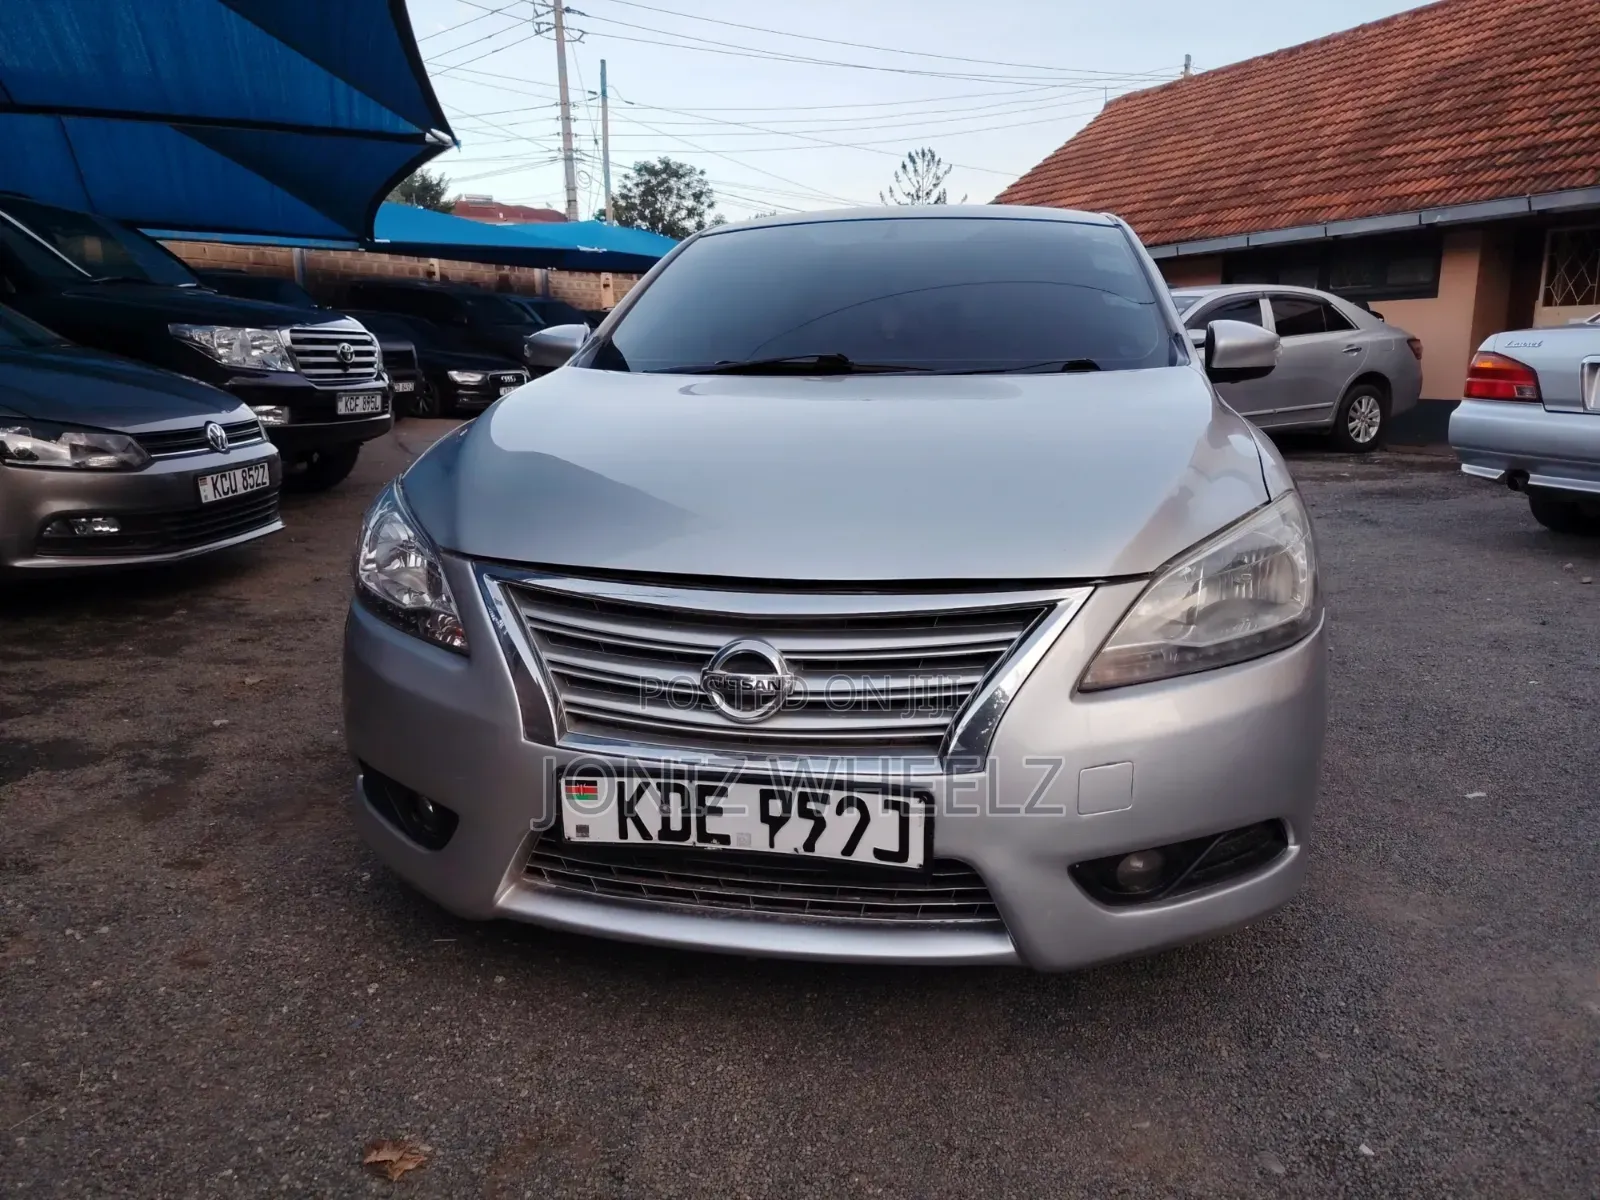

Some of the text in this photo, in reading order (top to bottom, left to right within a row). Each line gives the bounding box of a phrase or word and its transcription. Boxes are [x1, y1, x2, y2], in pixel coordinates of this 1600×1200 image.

[344, 396, 360, 412] KCF
[211, 465, 267, 499] KCU 852Z
[617, 780, 732, 846] KDE
